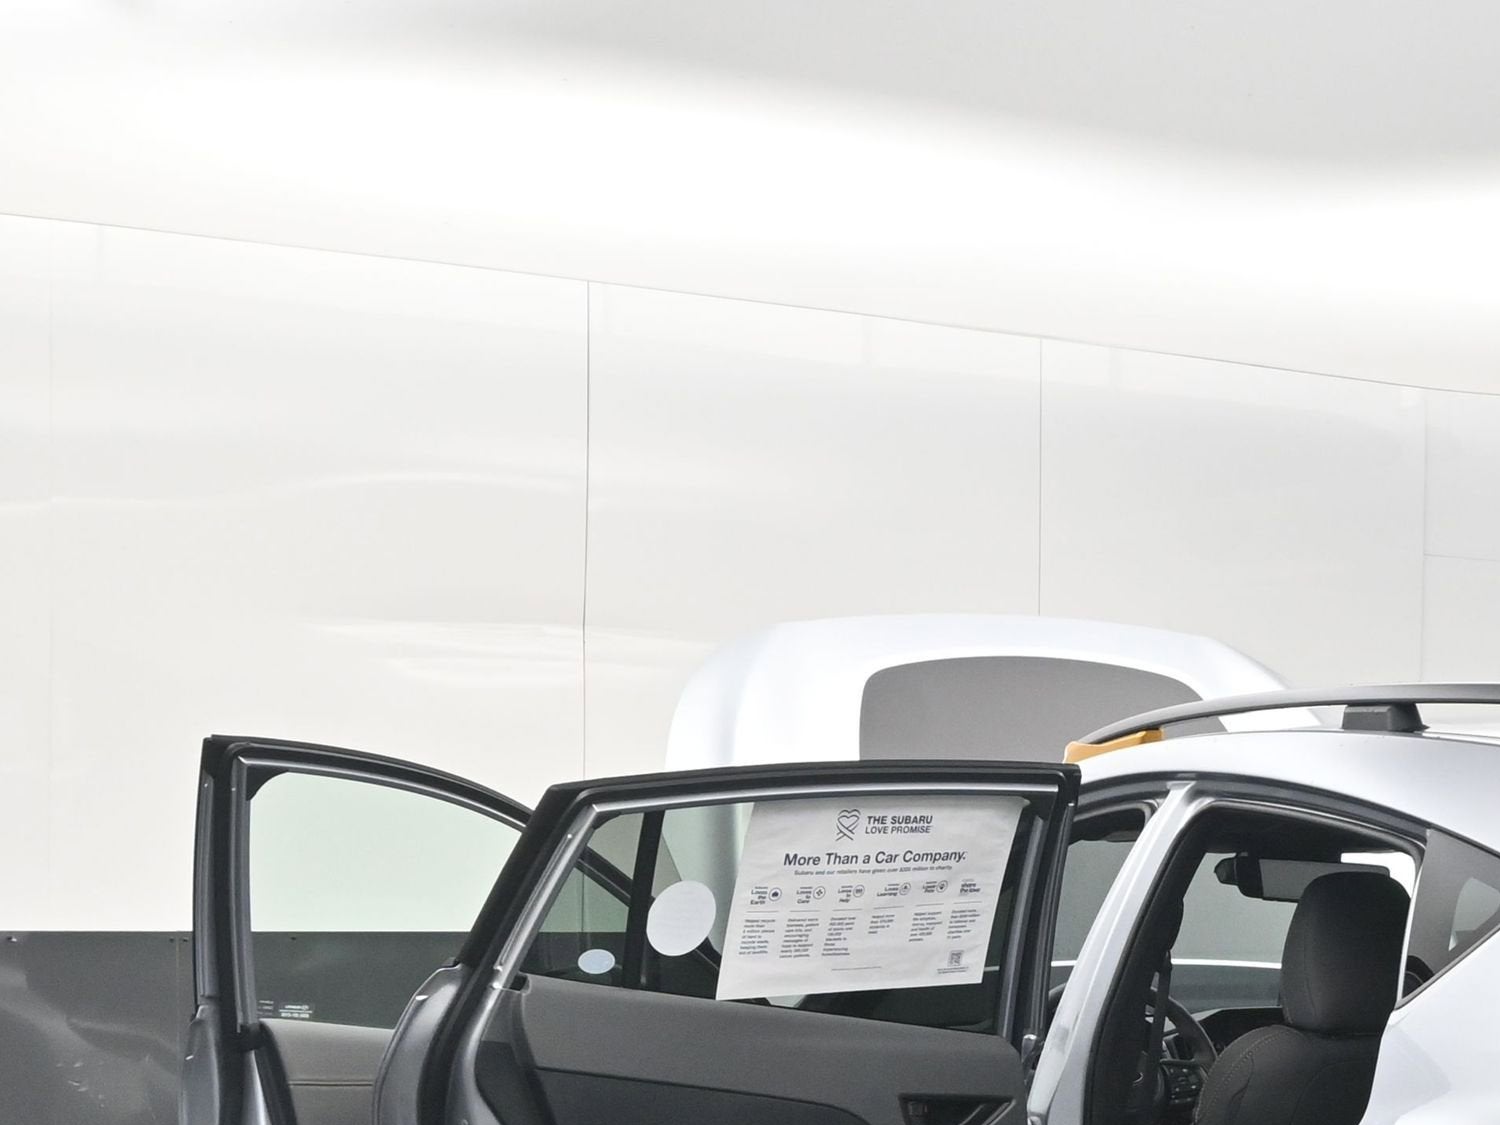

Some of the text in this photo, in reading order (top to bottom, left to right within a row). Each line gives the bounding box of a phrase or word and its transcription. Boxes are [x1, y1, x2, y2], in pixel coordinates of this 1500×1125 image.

[867, 815, 933, 825] THE SUBARU
[865, 825, 932, 834] LOVE PROMISE
[783, 849, 967, 866] More Than a Car Company.
